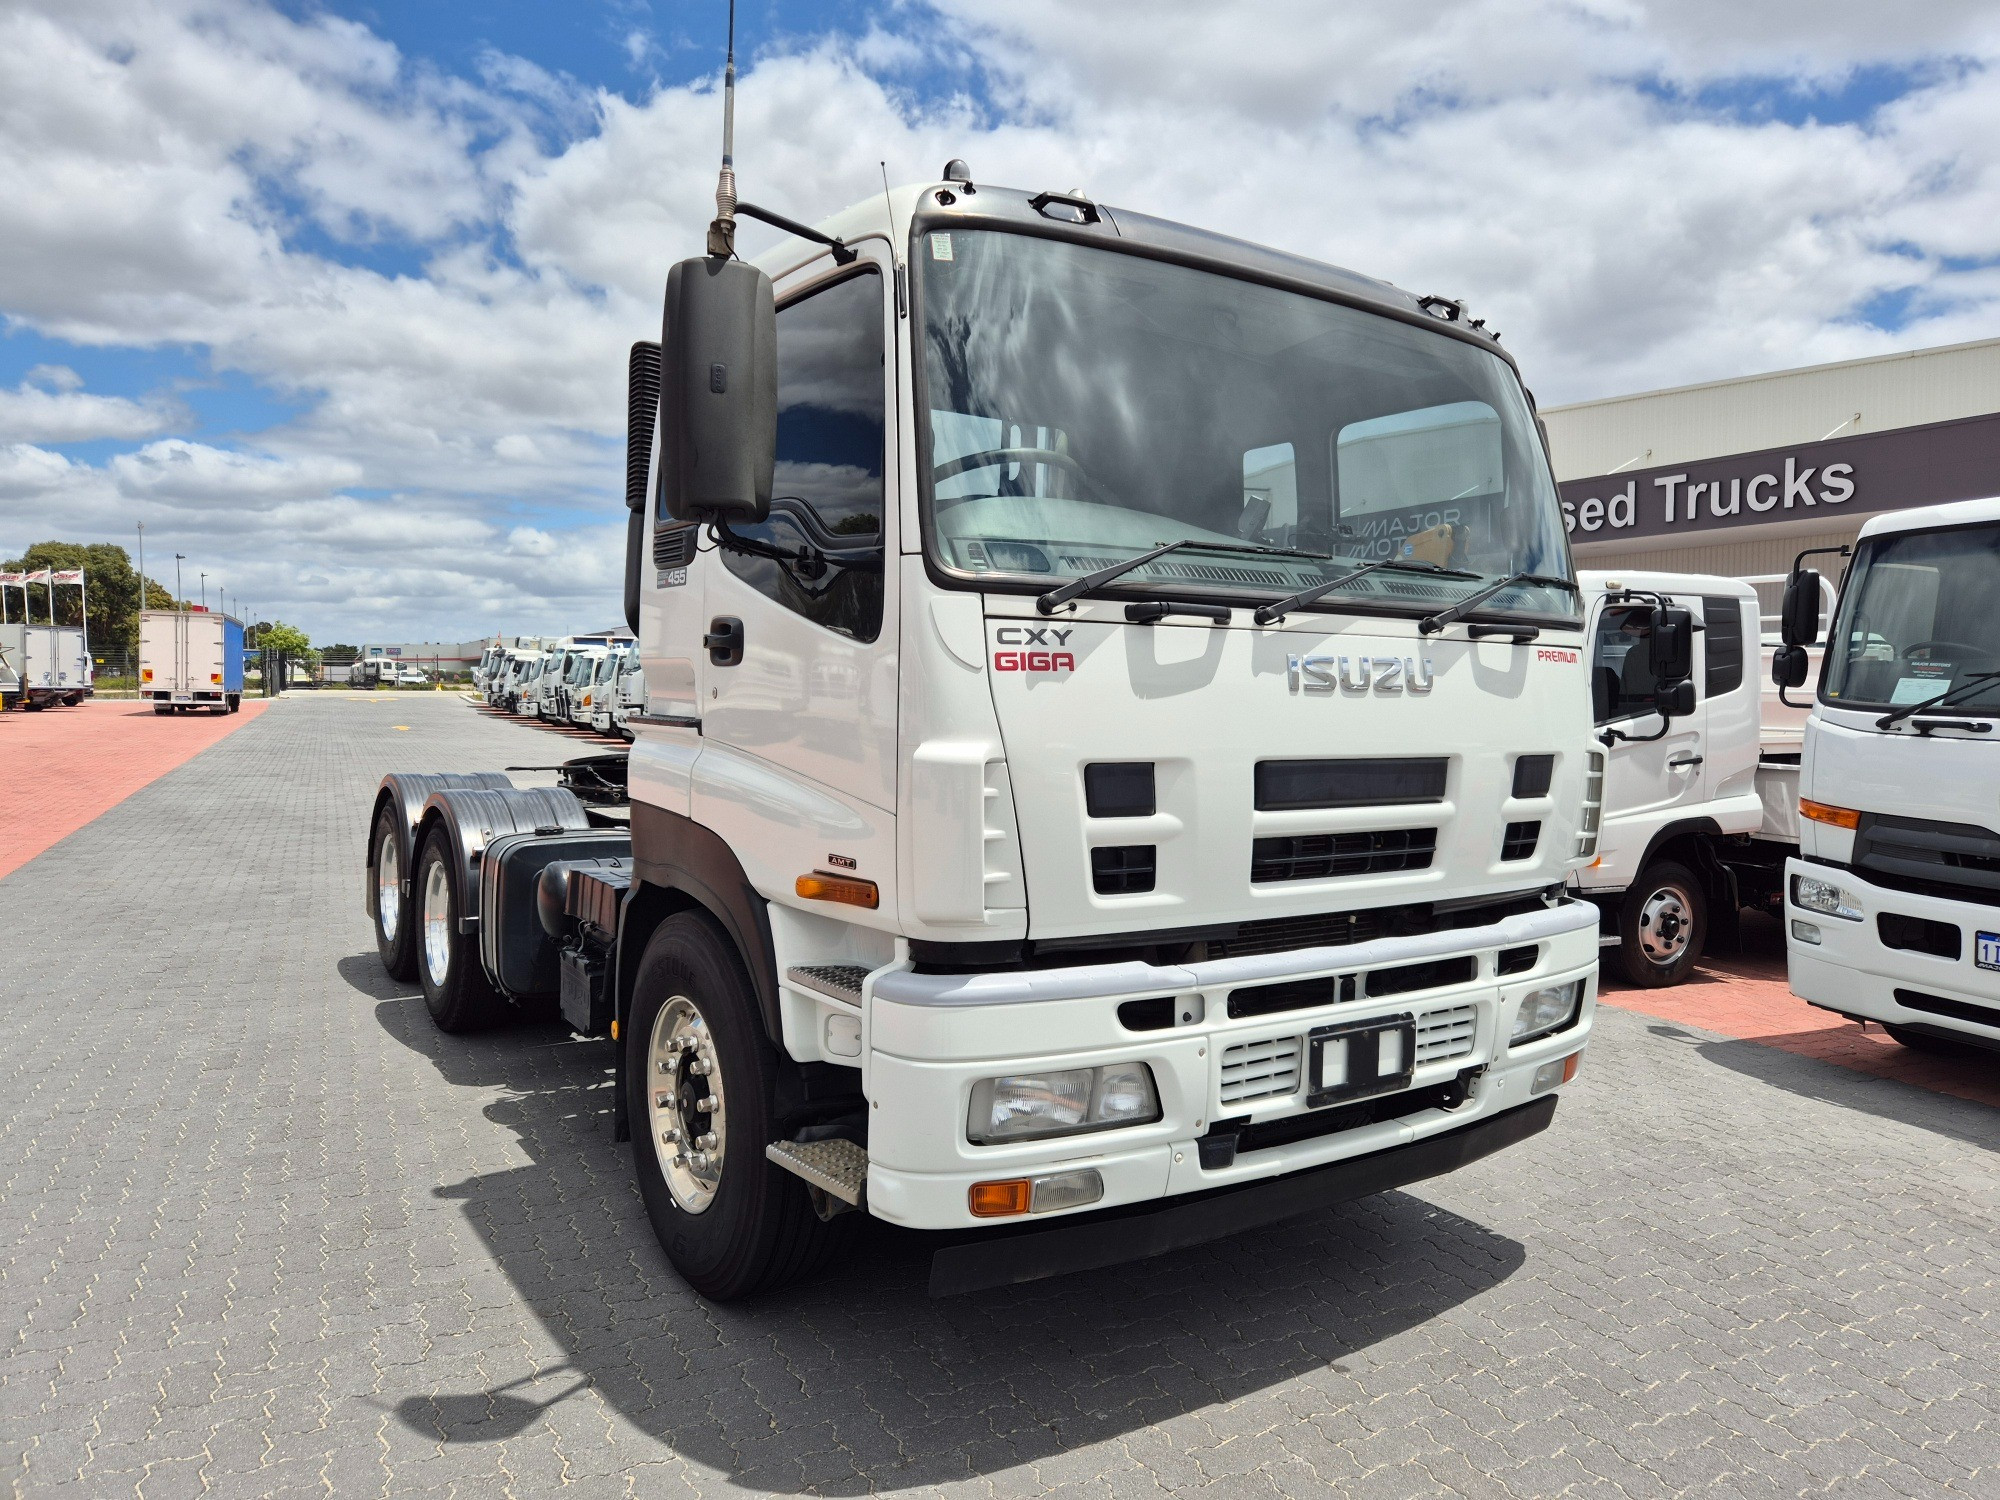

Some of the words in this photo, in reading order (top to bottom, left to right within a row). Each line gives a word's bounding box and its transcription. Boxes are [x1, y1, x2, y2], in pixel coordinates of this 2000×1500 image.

[1562, 480, 1636, 533] sed
[1654, 457, 1856, 523] Trucks
[1362, 508, 1461, 538] MAJOR
[1348, 536, 1408, 559] MOT
[668, 569, 686, 585] 455
[996, 627, 1074, 646] CXY
[994, 652, 1075, 672] GIGA
[1537, 650, 1578, 664] PREMIUM
[1286, 653, 1435, 694] ISUZU
[831, 857, 851, 867] AMT
